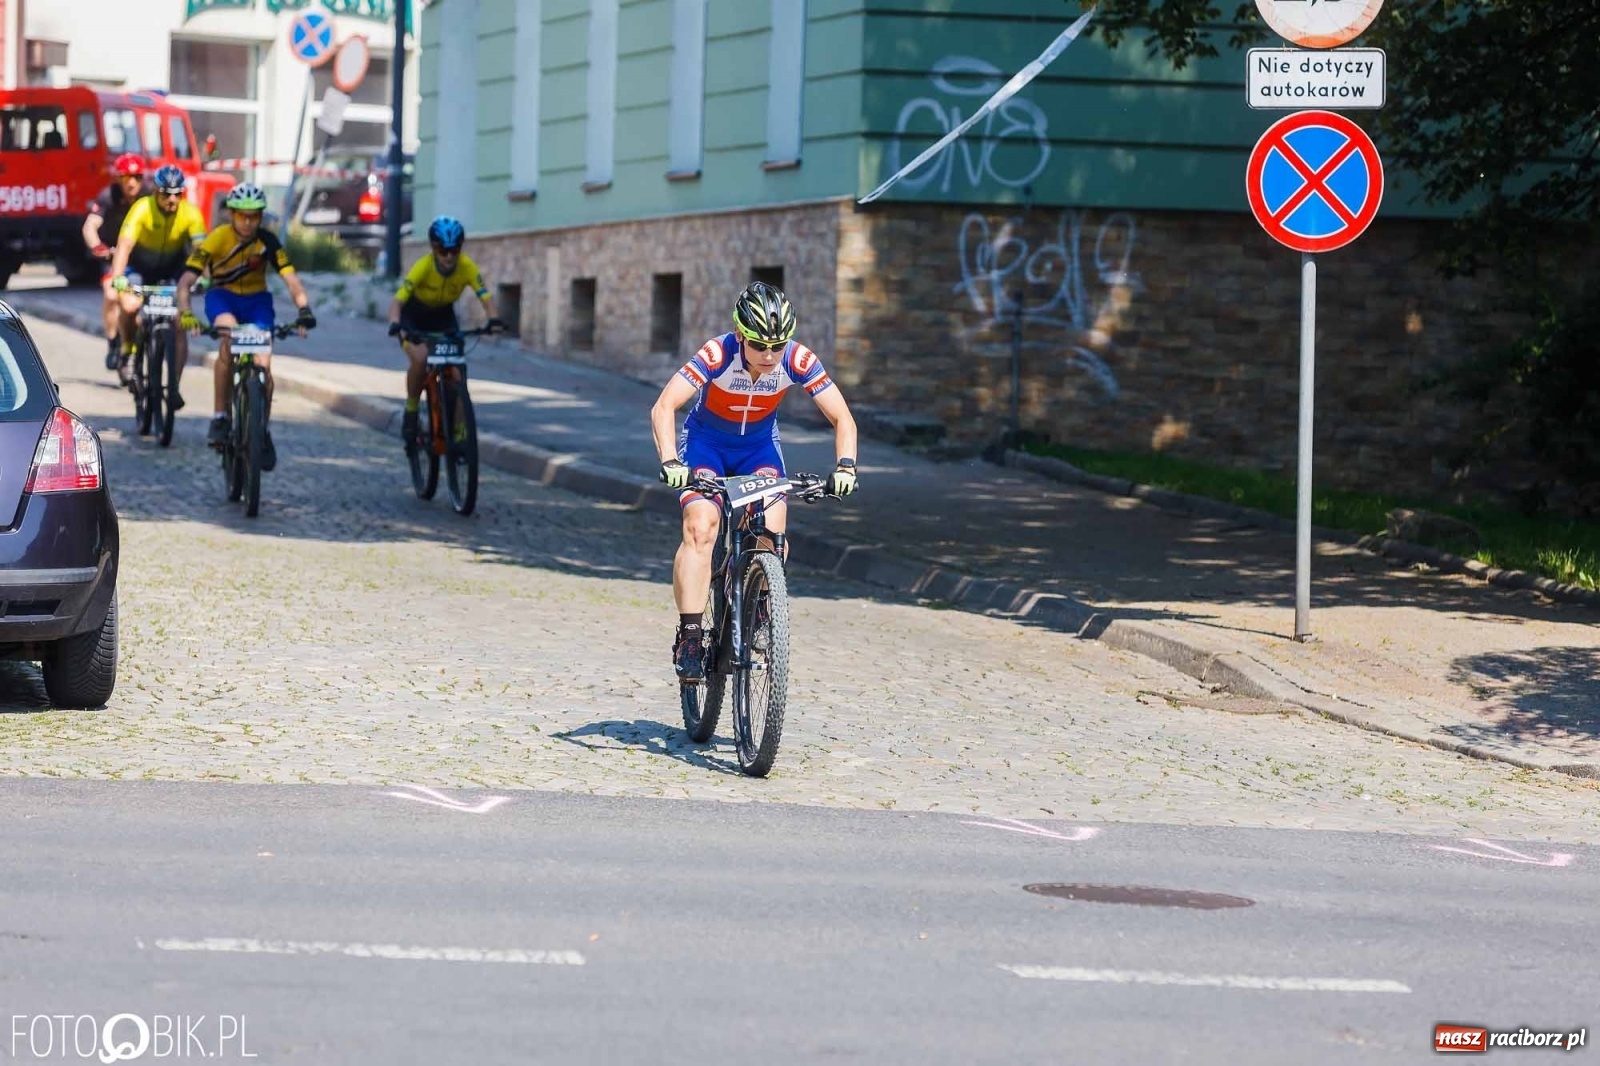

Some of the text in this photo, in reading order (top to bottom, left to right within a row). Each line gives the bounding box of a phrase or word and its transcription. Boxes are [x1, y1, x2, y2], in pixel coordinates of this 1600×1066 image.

[1258, 57, 1373, 78] Nie dotyczy
[1260, 81, 1365, 97] autokarów
[738, 478, 777, 493] 1930
